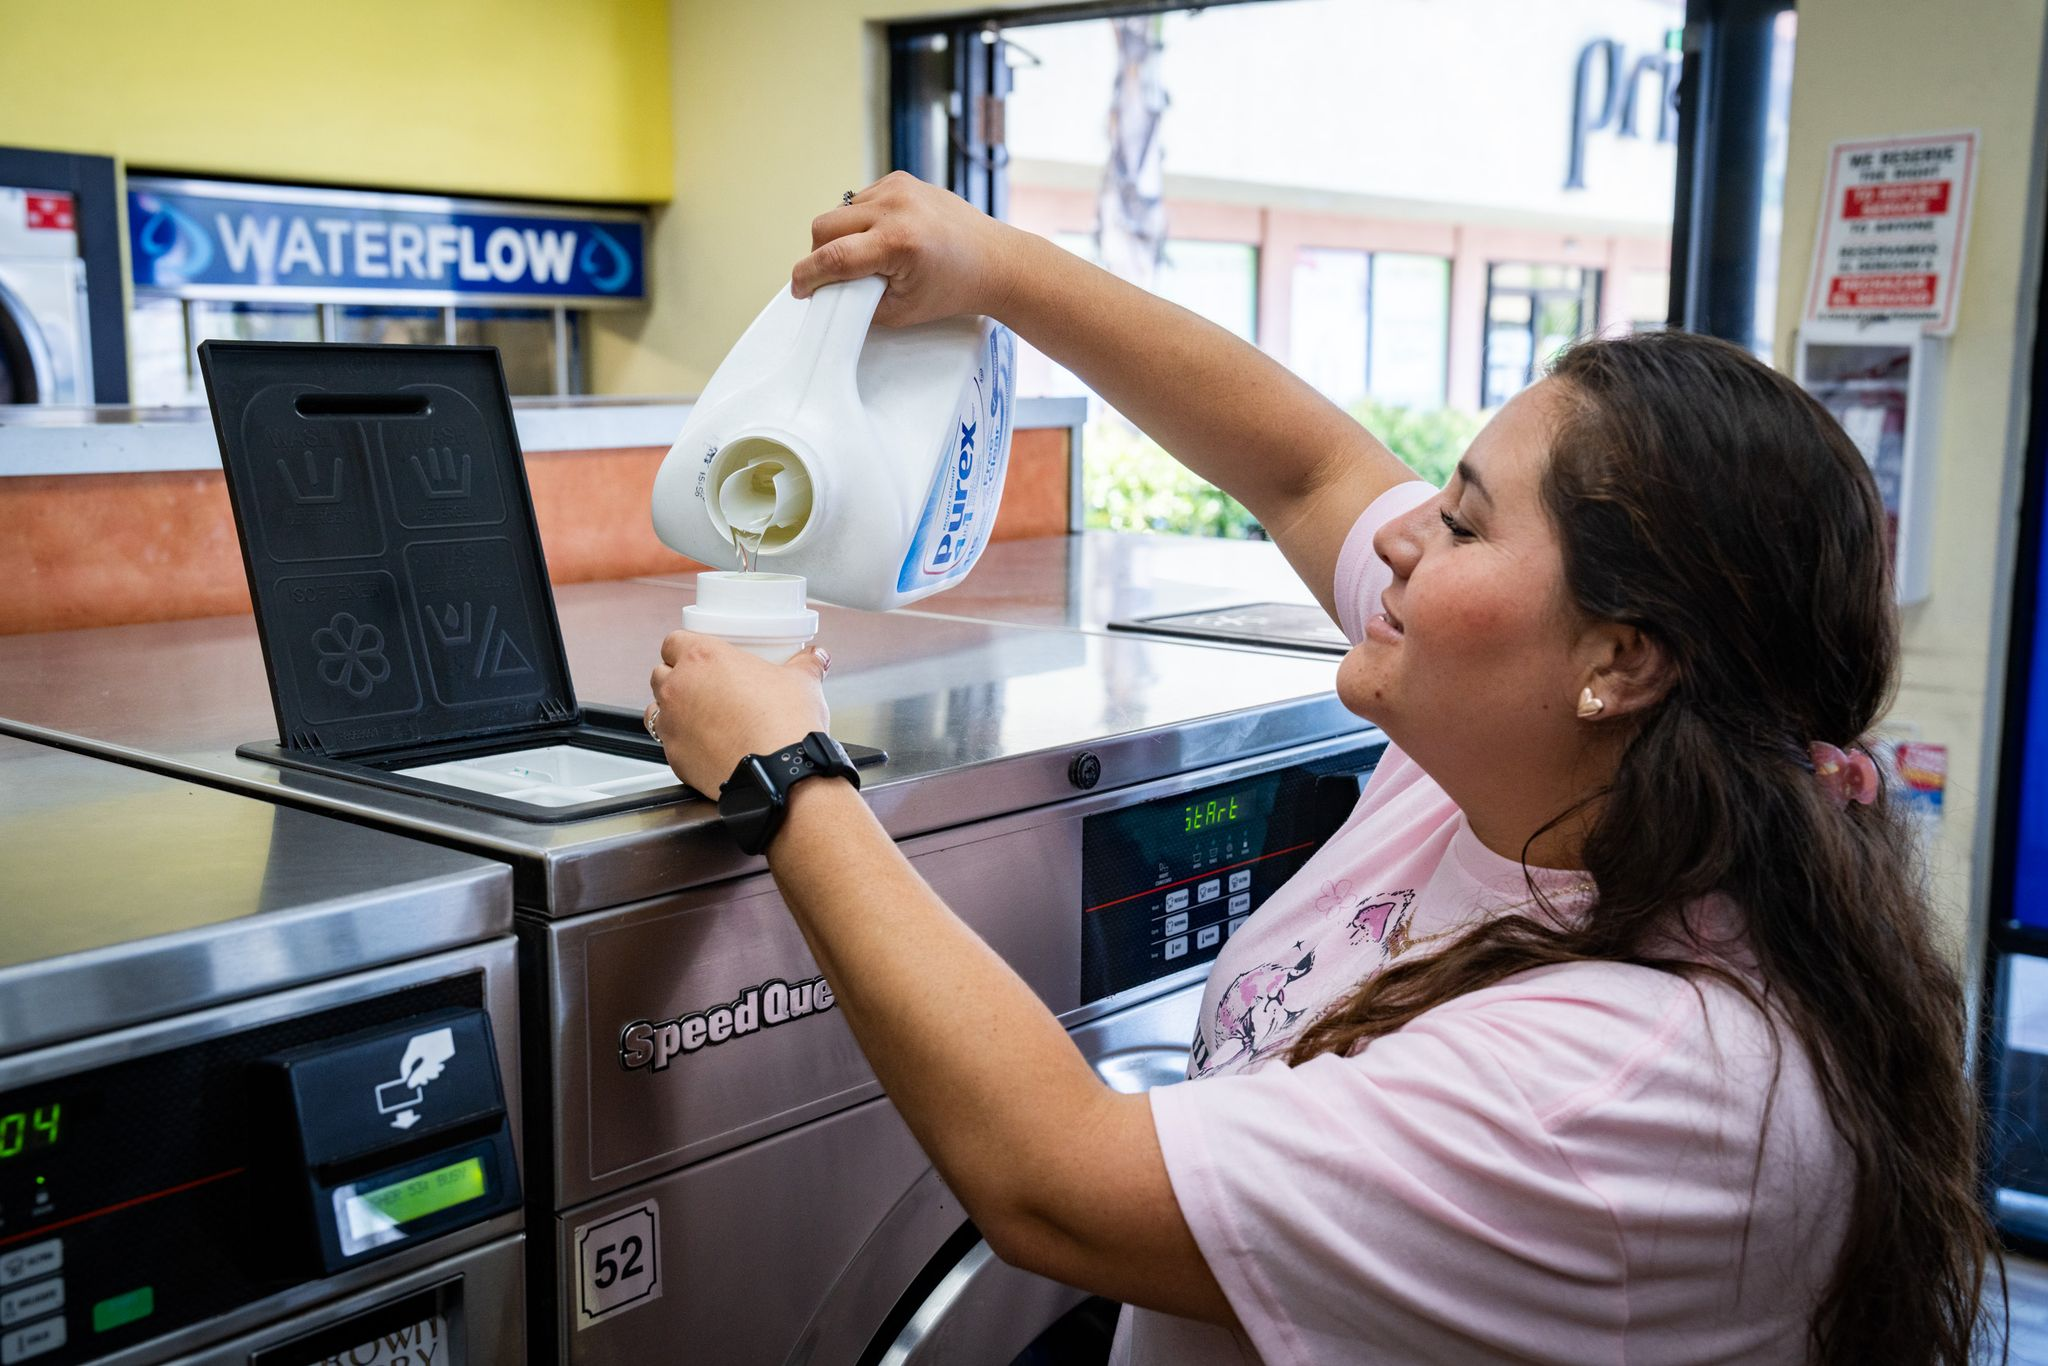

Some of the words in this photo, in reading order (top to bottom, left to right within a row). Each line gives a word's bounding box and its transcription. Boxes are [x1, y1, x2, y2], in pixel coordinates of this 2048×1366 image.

[216, 212, 578, 285] WATERFLOW
[933, 421, 976, 564] Purex
[594, 1235, 644, 1288] 52
